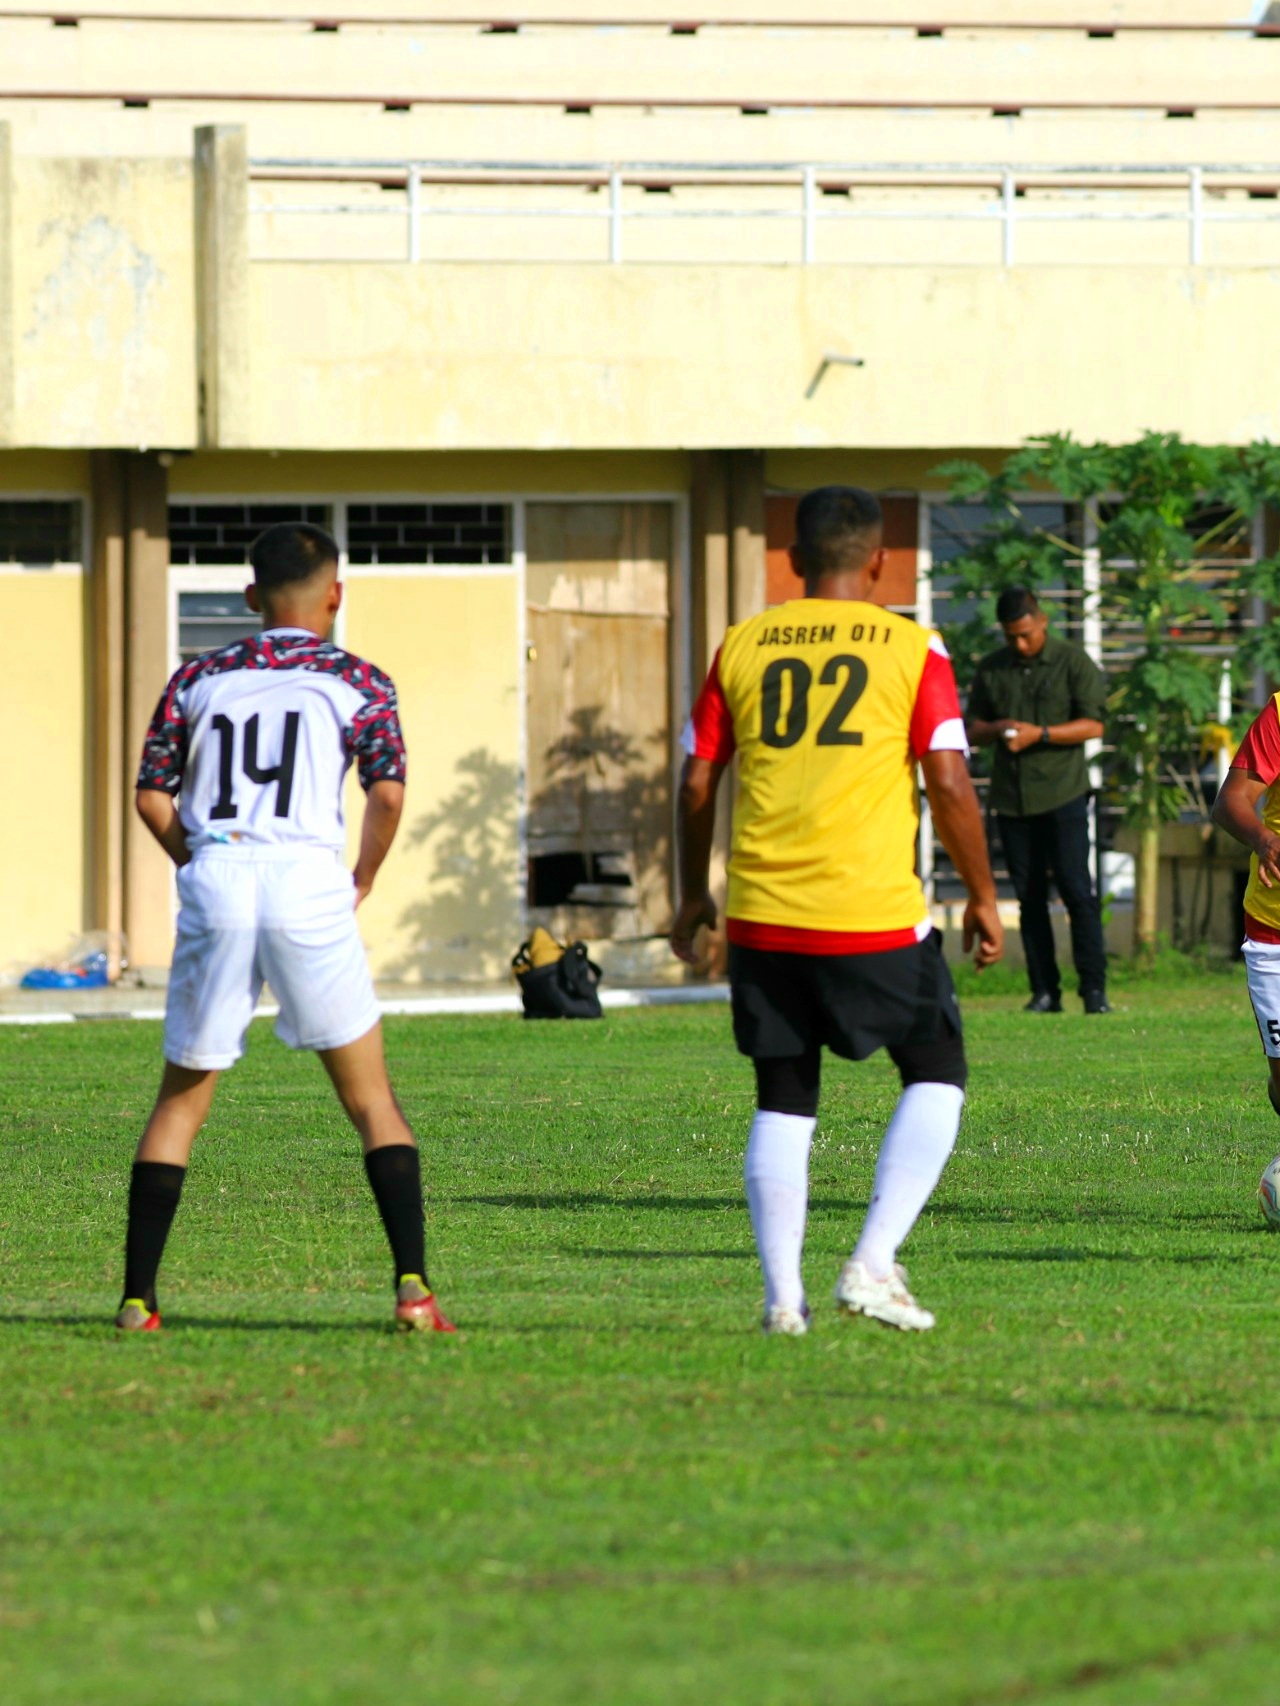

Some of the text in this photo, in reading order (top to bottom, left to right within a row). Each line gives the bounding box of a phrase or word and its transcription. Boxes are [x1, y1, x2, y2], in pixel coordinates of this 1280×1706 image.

[757, 624, 891, 646] JASREM 011
[761, 654, 868, 748] 02
[209, 711, 300, 820] 14
